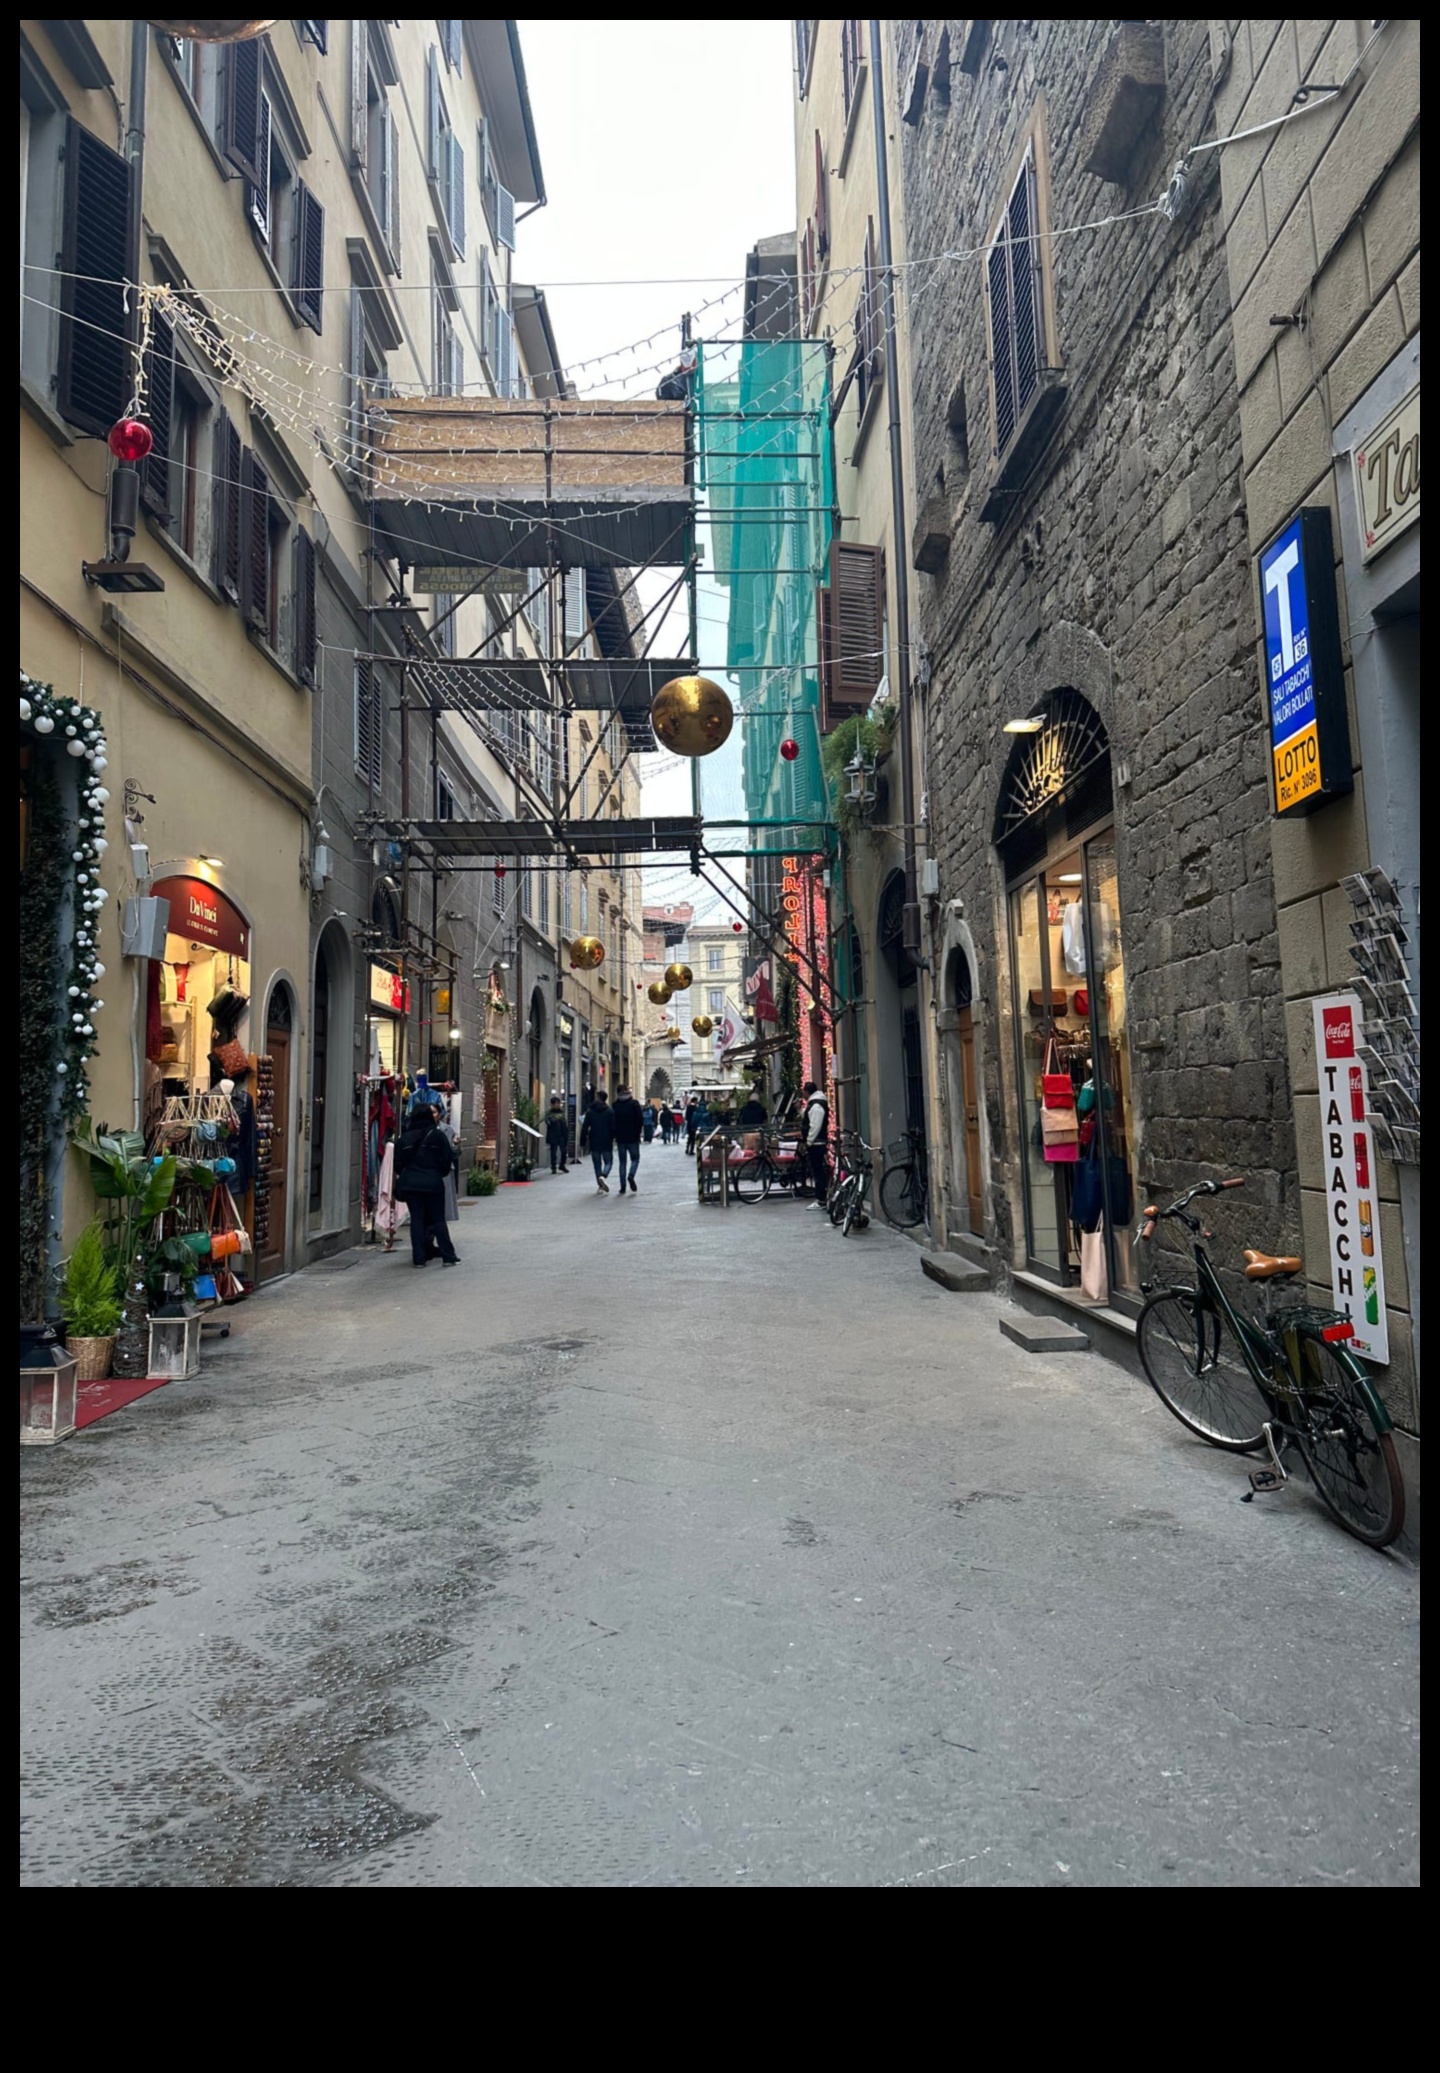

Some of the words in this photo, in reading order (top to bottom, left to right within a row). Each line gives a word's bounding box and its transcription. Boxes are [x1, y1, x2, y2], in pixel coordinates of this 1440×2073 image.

[1368, 428, 1420, 529] Ta
[1265, 538, 1299, 674] T
[1297, 641, 1306, 659] 36
[1273, 683, 1285, 705] SALI
[1284, 662, 1311, 697] TABACCHI
[1273, 701, 1292, 727] VALORI
[1291, 684, 1313, 714] BOLLATI
[1277, 735, 1316, 783] LOTTO
[1280, 785, 1293, 803] Ric.
[1301, 768, 1317, 790] 3096
[1325, 1021, 1351, 1040] Coca-Cola
